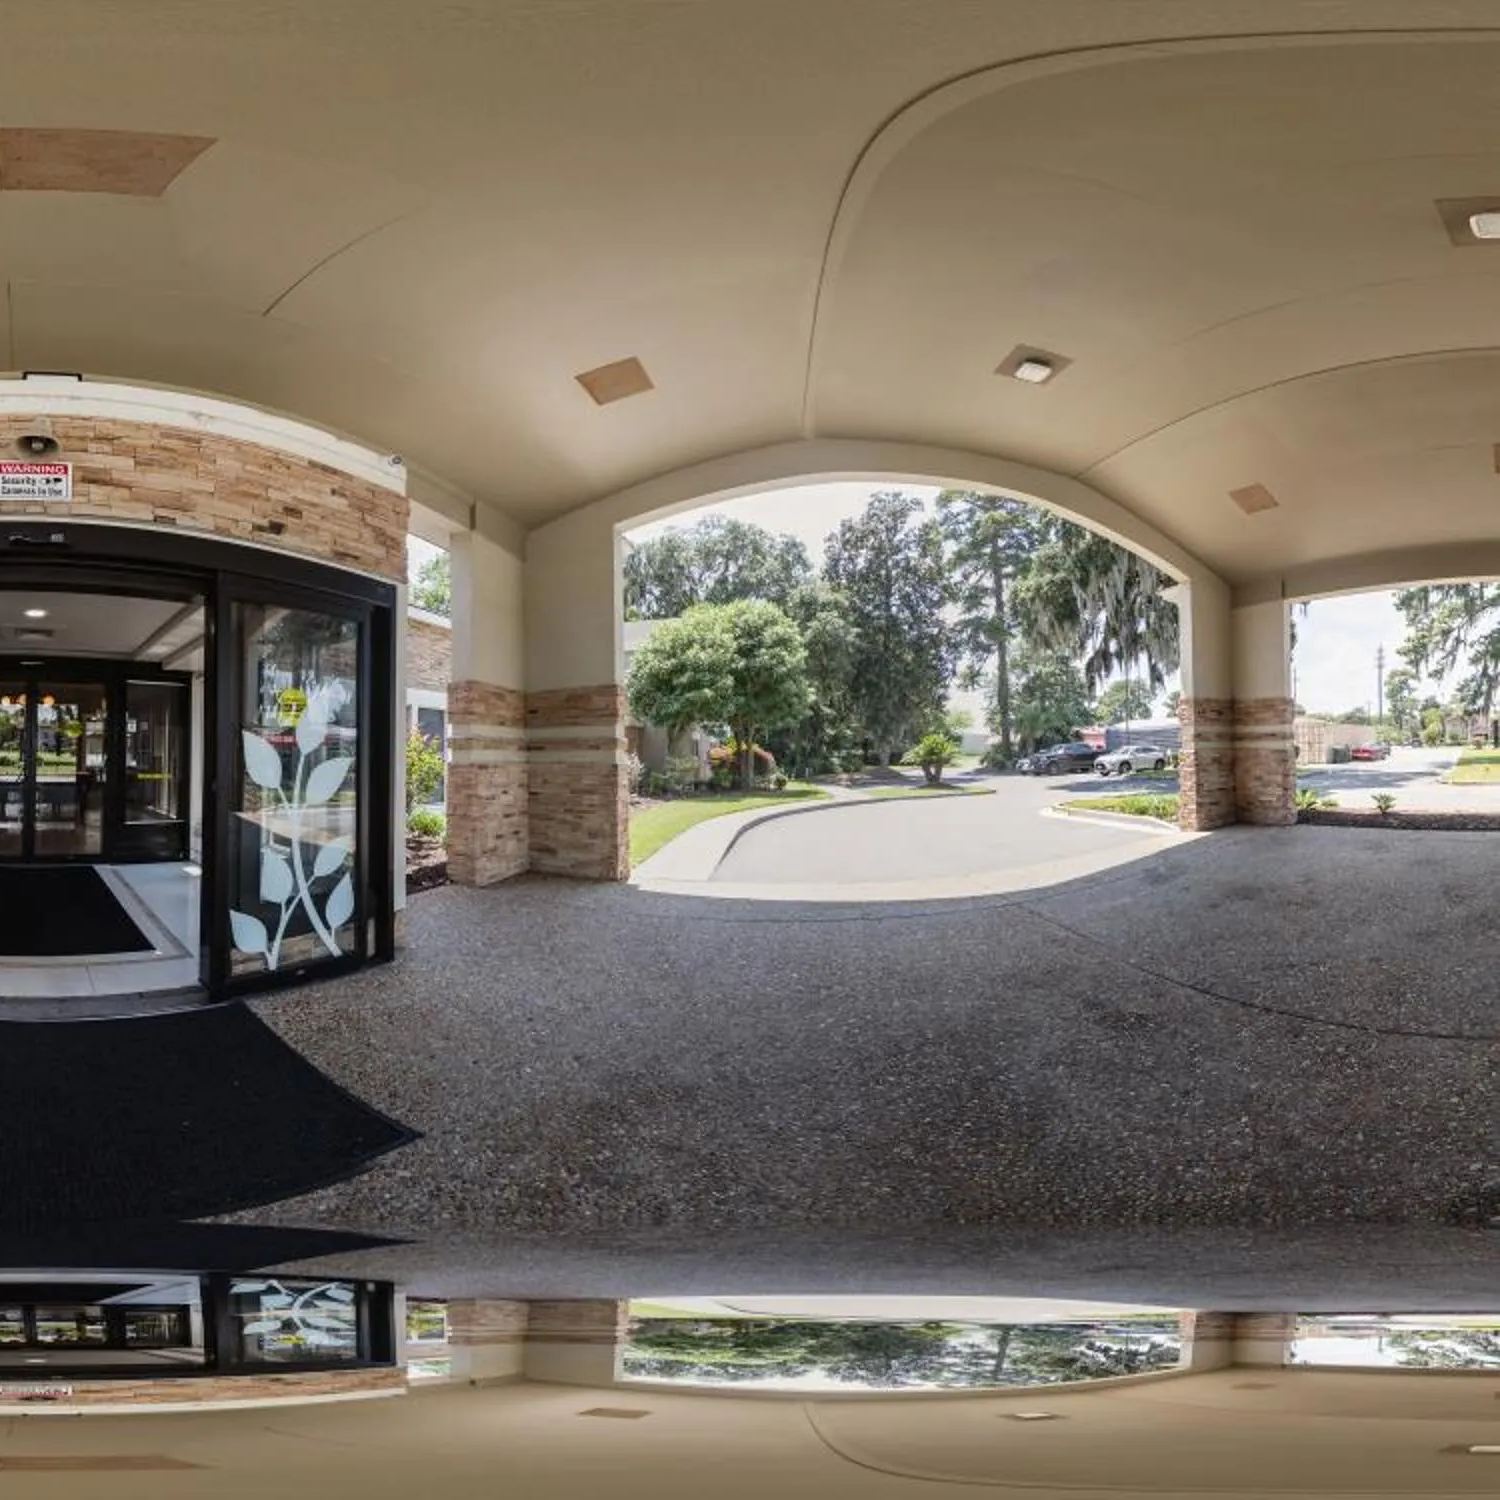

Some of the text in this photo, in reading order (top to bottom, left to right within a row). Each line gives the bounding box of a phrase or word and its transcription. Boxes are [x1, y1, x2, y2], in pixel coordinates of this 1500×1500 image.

[1, 465, 65, 473] WARNING
[1, 476, 36, 486] Security
[1, 486, 36, 494] Cameras
